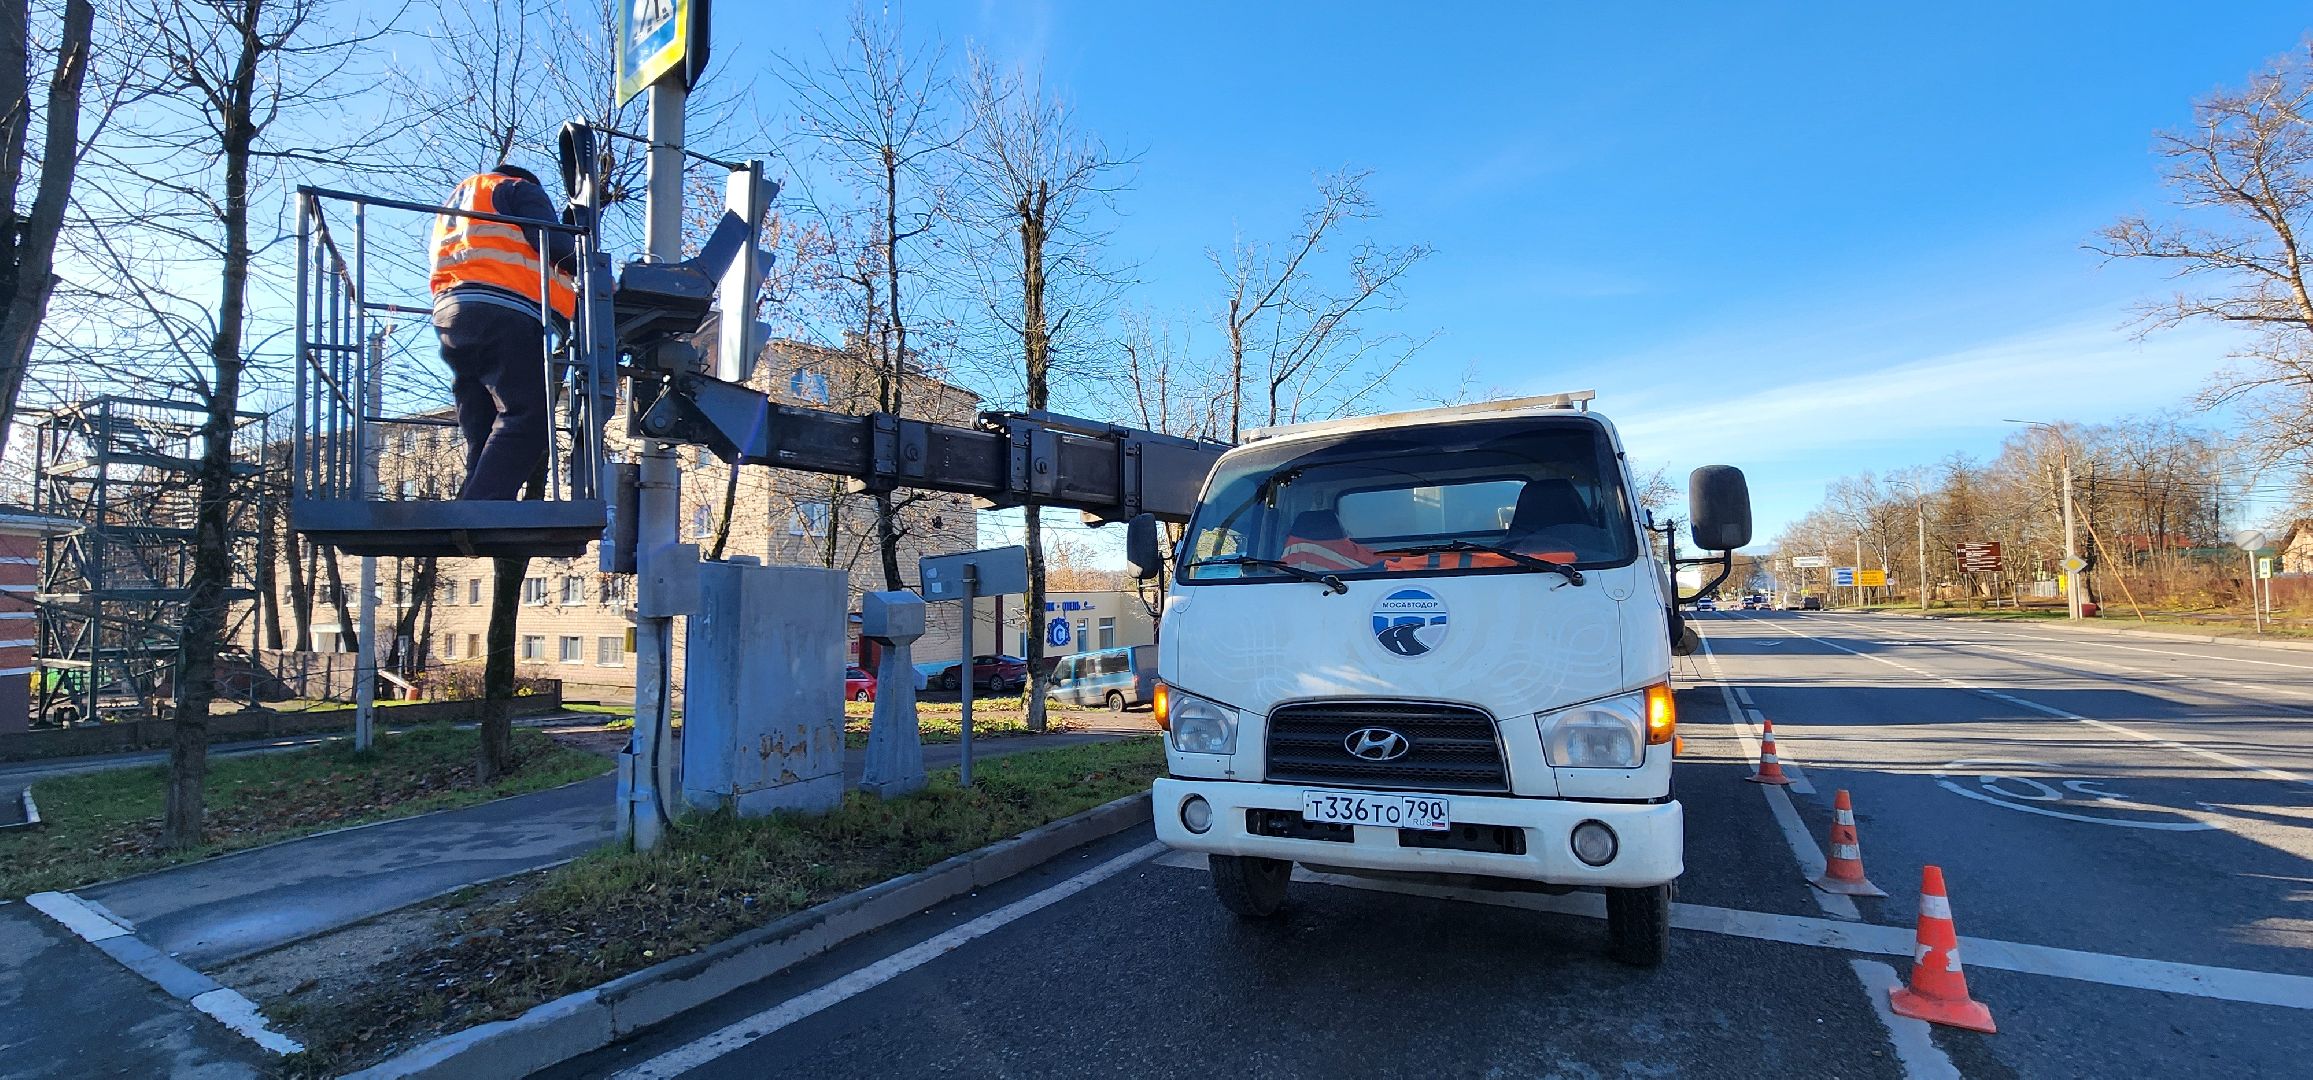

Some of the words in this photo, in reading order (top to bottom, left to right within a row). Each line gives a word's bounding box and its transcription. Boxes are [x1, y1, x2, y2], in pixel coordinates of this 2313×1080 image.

[1382, 601, 1438, 609] МОСАВТОДОР
[1405, 799, 1443, 820] 790
[1412, 818, 1431, 827] RUS
